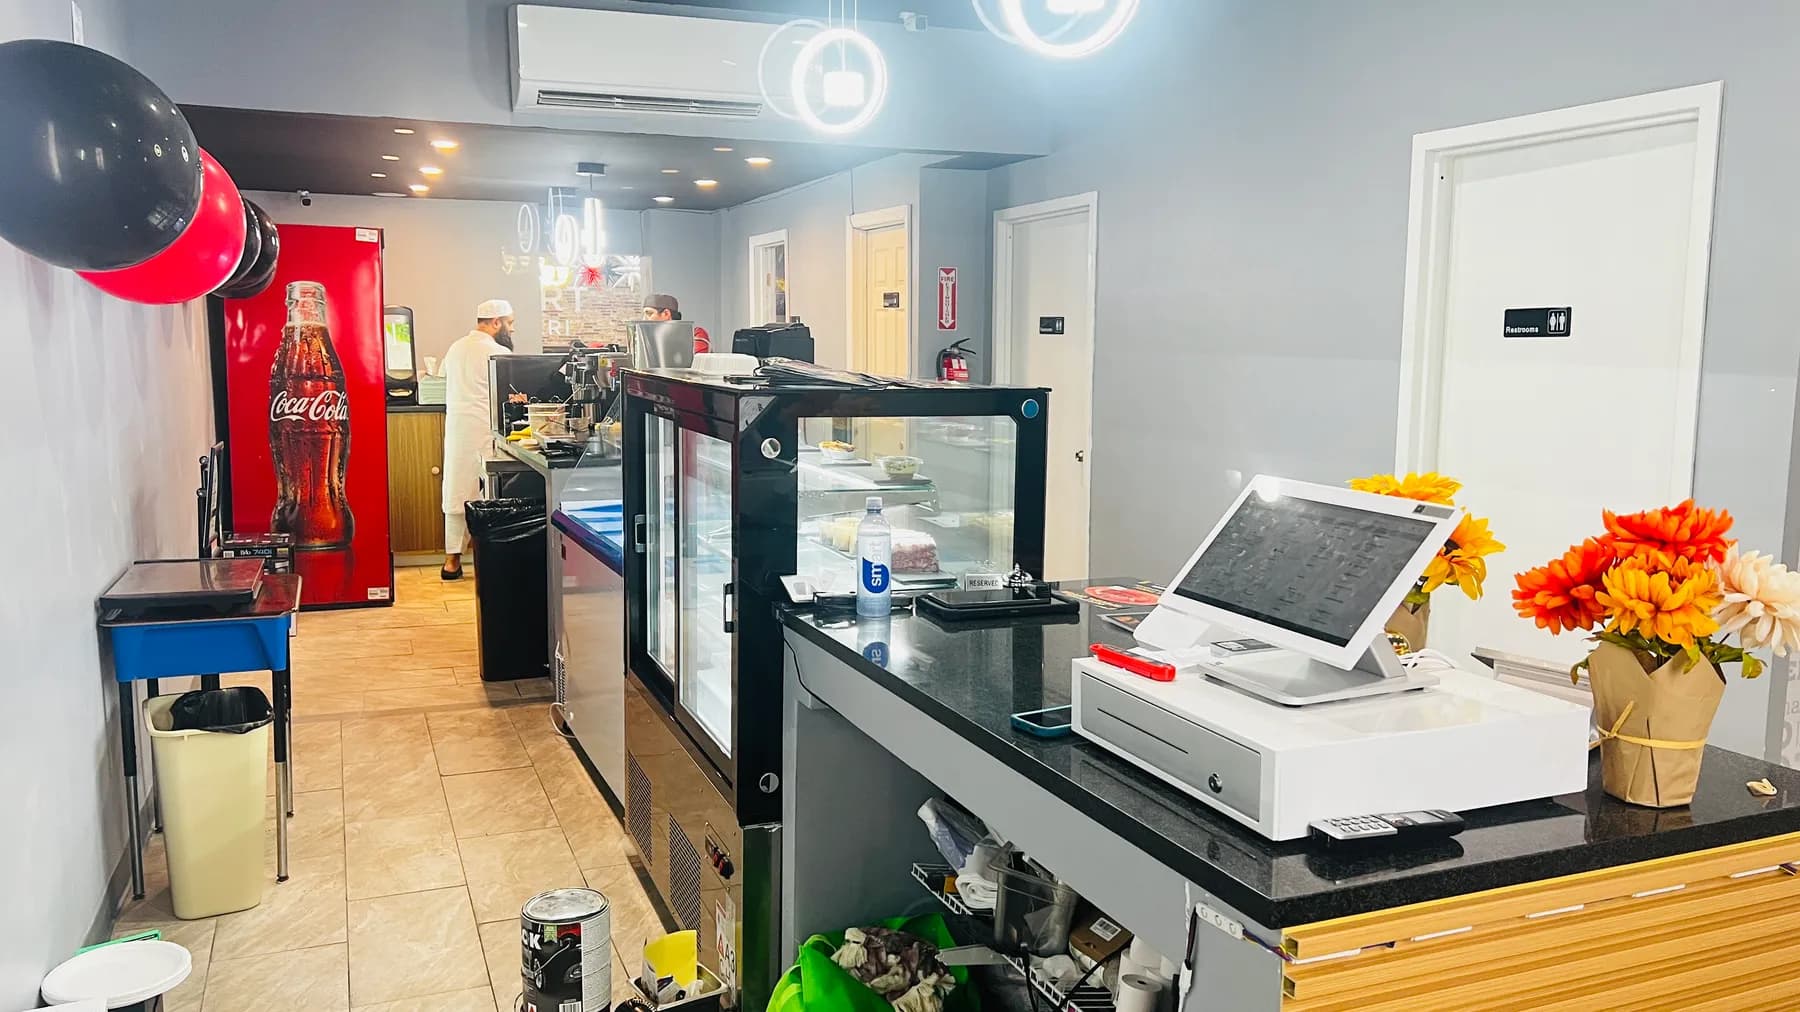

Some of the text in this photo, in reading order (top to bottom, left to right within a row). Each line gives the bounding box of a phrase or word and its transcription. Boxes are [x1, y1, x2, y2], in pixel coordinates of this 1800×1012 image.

[1505, 326, 1539, 334] Restrooms
[270, 390, 349, 422] Coca-Cola
[870, 541, 882, 587] smart
